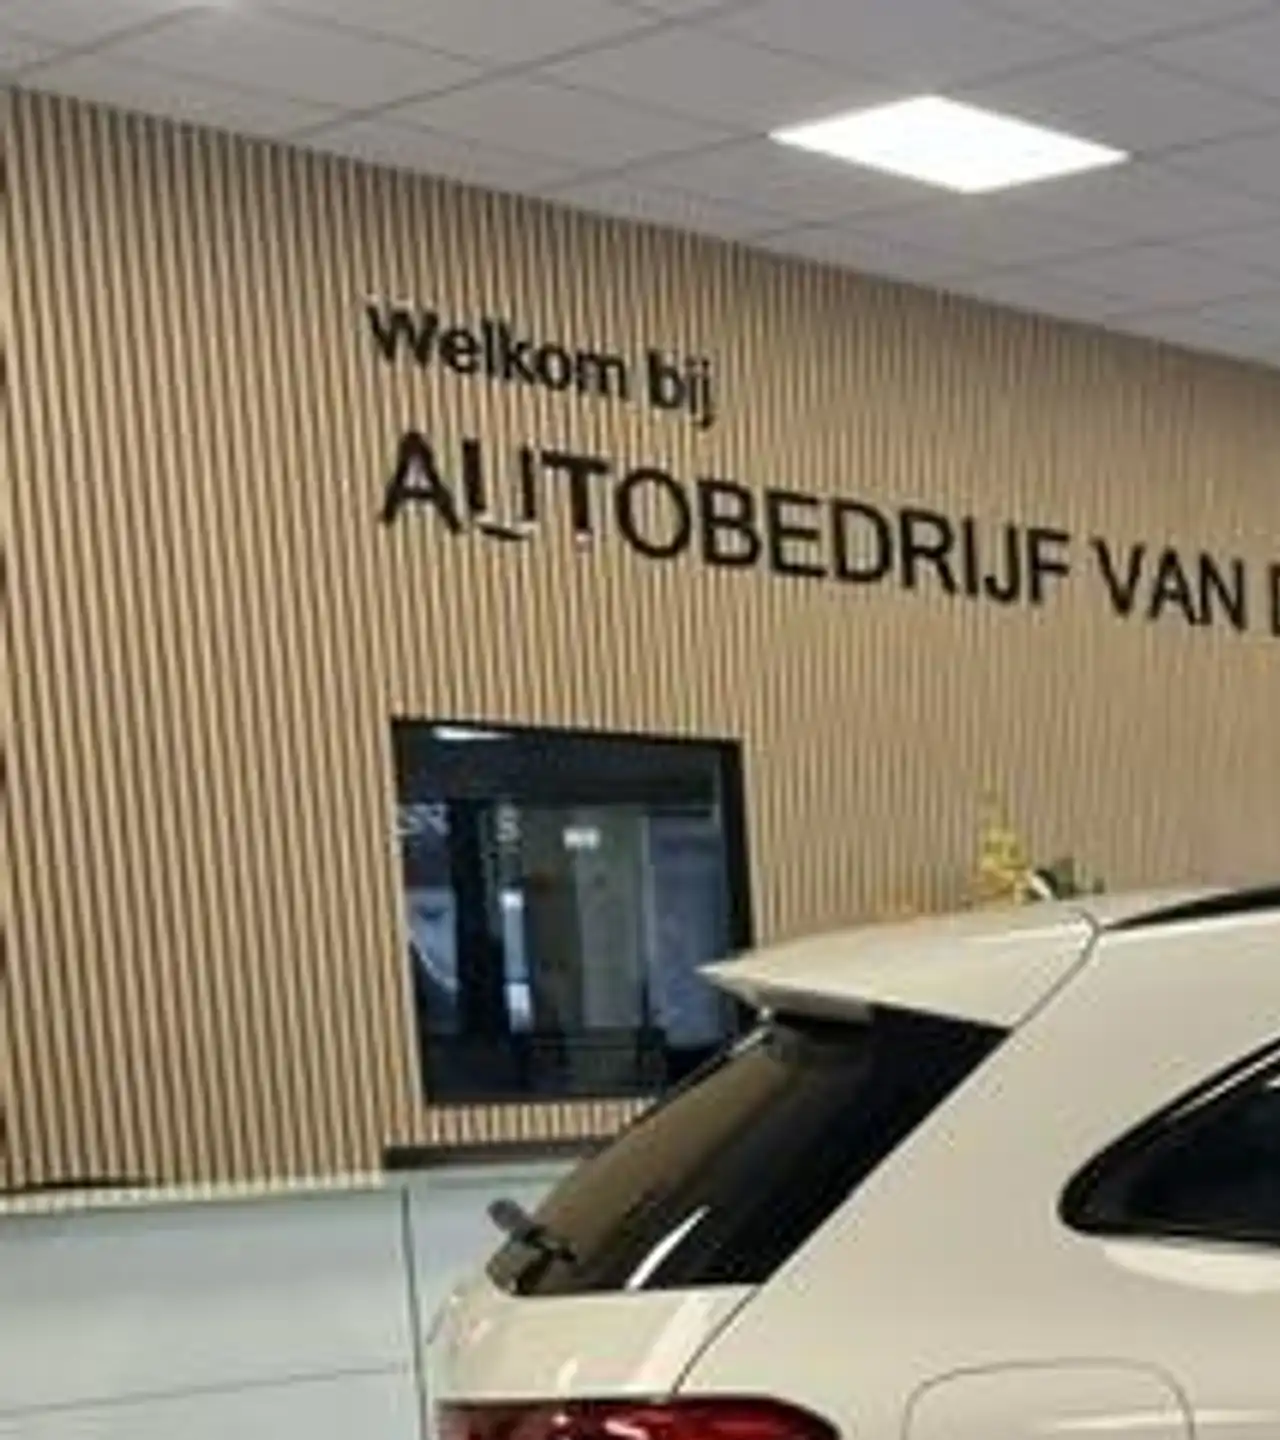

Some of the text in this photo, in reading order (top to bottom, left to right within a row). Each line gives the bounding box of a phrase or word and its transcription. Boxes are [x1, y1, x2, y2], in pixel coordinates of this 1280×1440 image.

[366, 305, 712, 430] Welkom bij
[382, 430, 1072, 606] AUTOBEDRIJF
[1093, 536, 1248, 636] VAN
